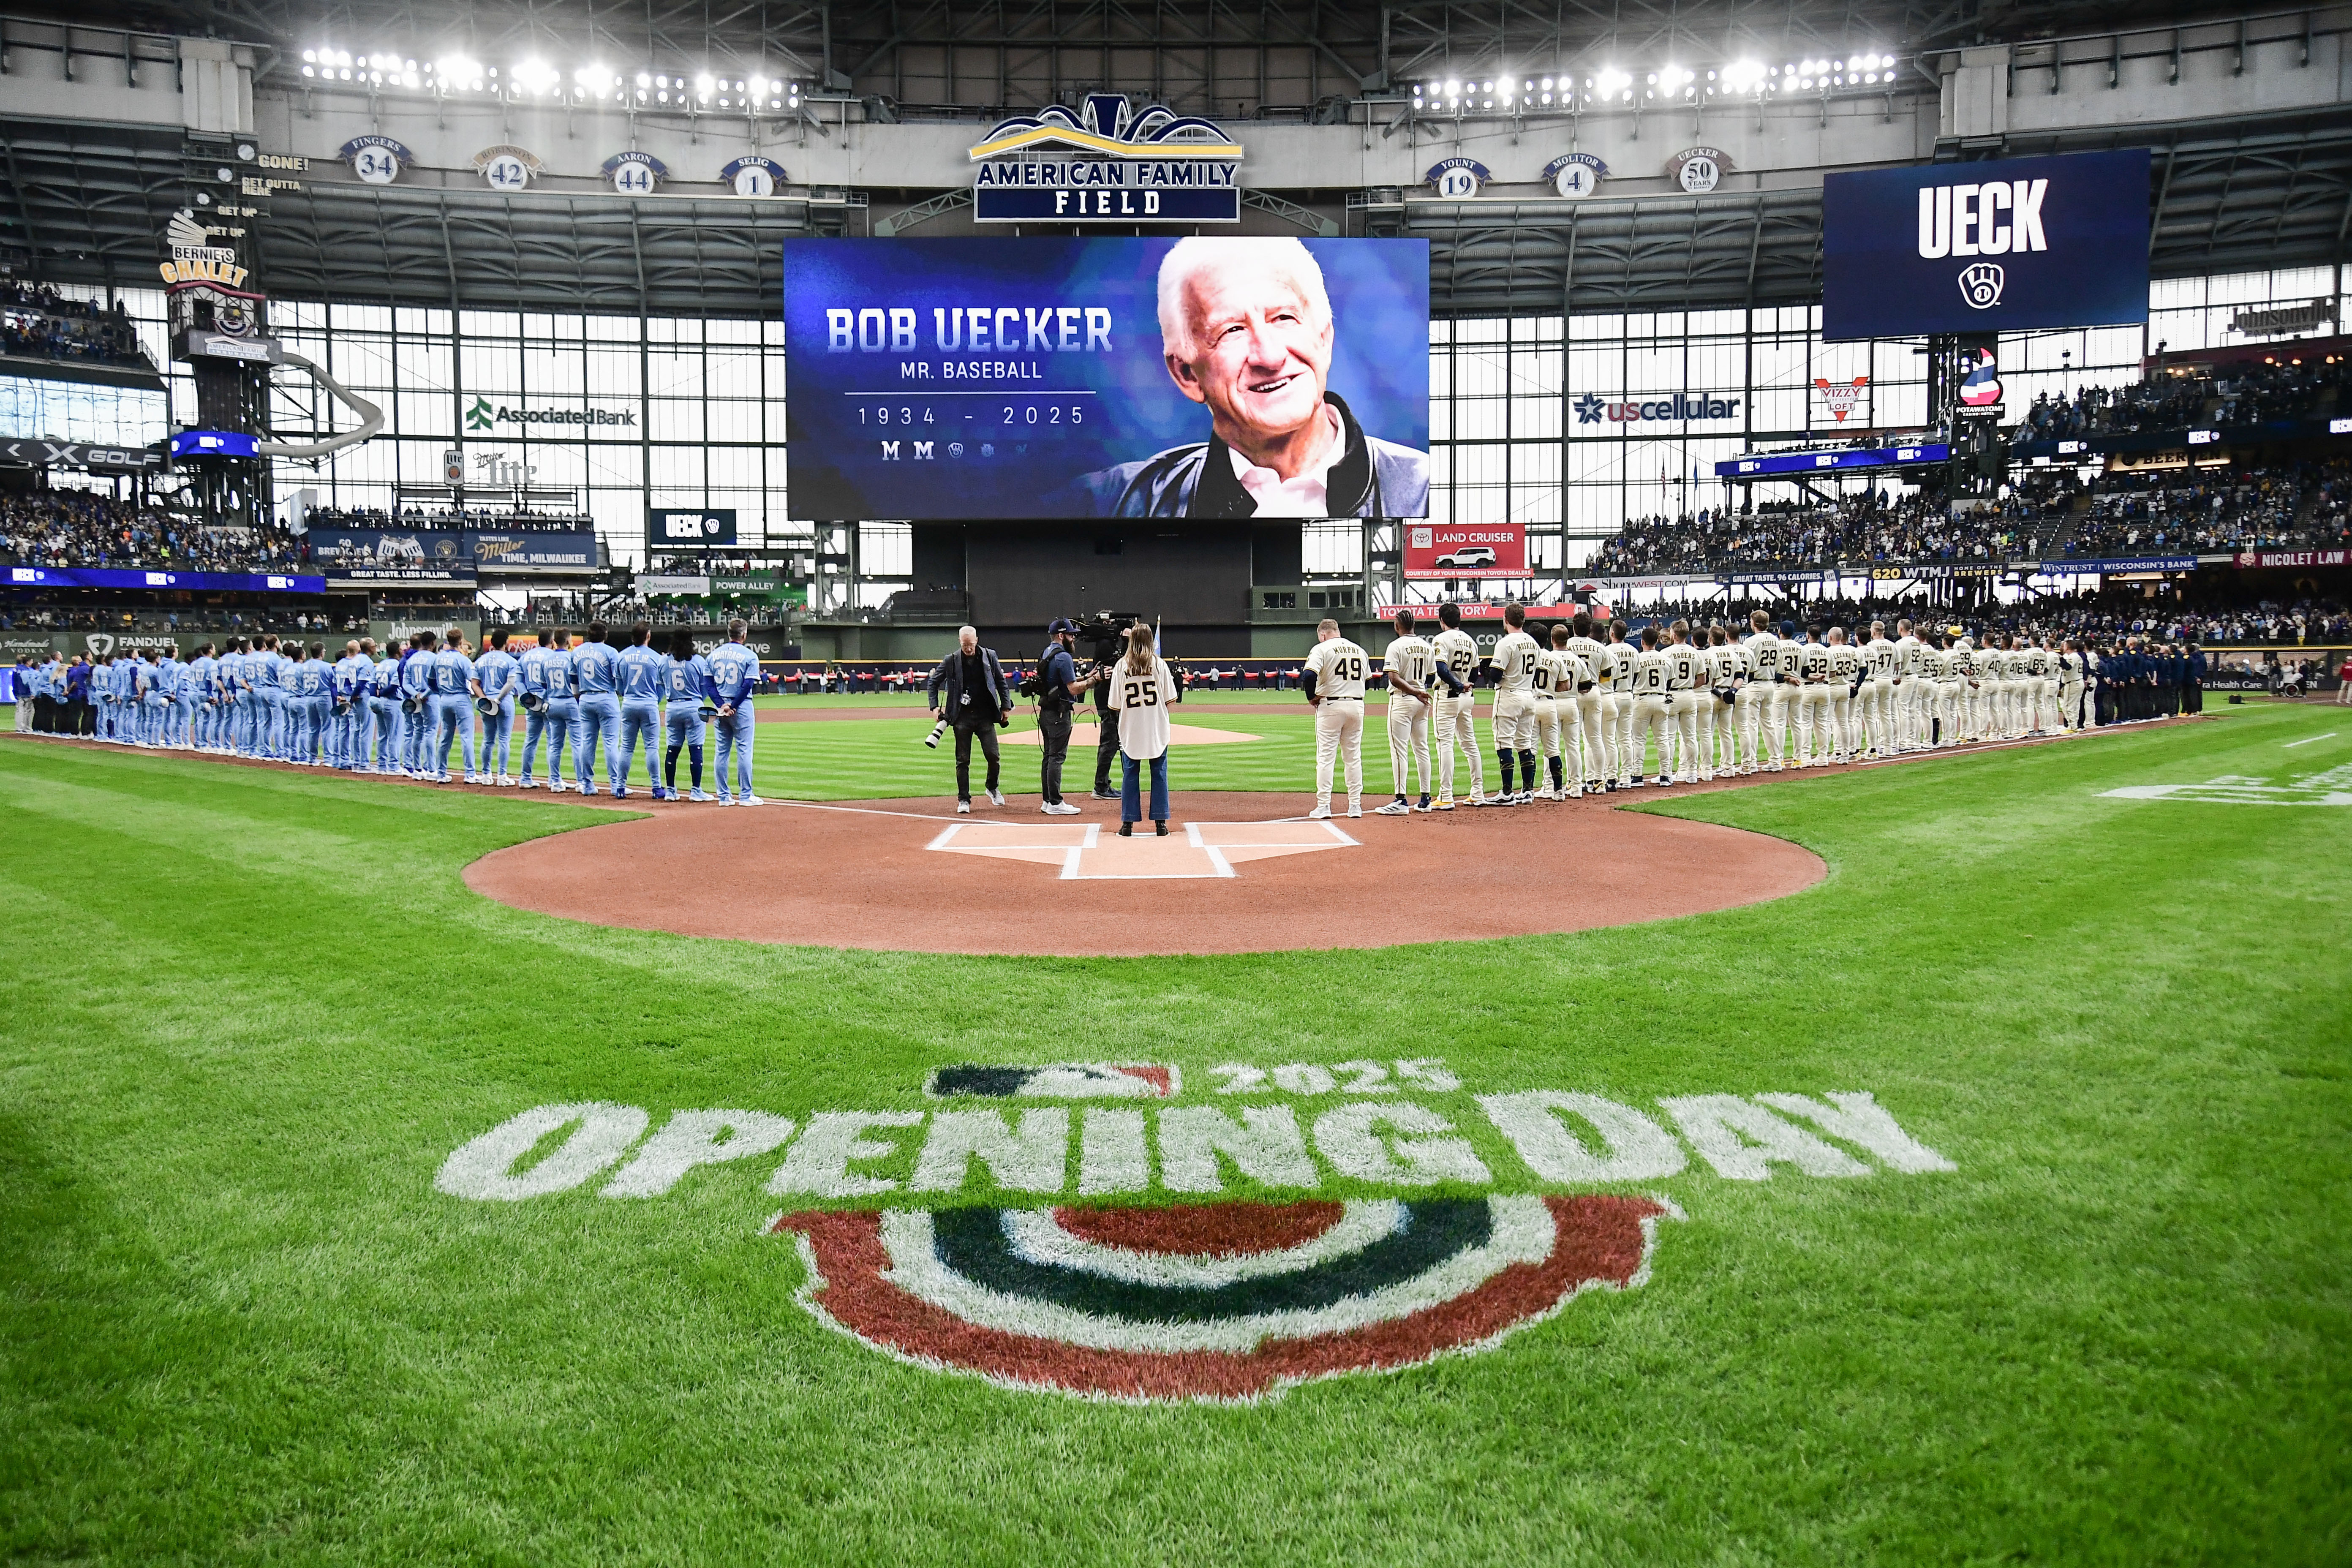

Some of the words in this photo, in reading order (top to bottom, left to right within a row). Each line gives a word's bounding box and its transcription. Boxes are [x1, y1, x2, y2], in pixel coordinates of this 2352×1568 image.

[352, 136, 401, 152] FINGERS
[482, 146, 531, 160] ROBINSON
[618, 152, 652, 164] AARON
[1678, 148, 1718, 161] UECKER
[258, 155, 309, 171] GONE!
[361, 154, 393, 177] 34
[738, 158, 769, 167] SELIG
[1440, 158, 1476, 169] YOUNT
[1552, 155, 1598, 169] MOLITOR
[491, 163, 524, 185] 42
[977, 162, 1126, 188] AMERICAN
[1136, 162, 1240, 188] FAMILY
[1687, 162, 1712, 180] 50
[242, 177, 263, 188] GET
[265, 178, 301, 190] OUTTA
[619, 169, 650, 191] 44
[750, 175, 761, 195] 1
[1445, 174, 1472, 196] 19
[1567, 172, 1582, 191] 4
[242, 186, 272, 196] HERE
[1056, 191, 1160, 214] FIELD
[218, 205, 239, 216] GET
[242, 207, 258, 218] UP
[1918, 177, 2049, 259] UECK
[206, 226, 228, 236] GET
[230, 228, 246, 237] UP
[175, 247, 234, 262] BERNIE'S
[160, 260, 248, 288] CHALET
[826, 308, 917, 353] BOB
[933, 307, 1113, 352] UECKER
[901, 362, 935, 379] MR.
[943, 361, 1043, 379] BASEBALL
[1822, 388, 1861, 397] VIZZY
[858, 407, 934, 425] 1934
[1003, 406, 1083, 424] 2025
[87, 450, 162, 466] GOLF
[882, 441, 900, 461] M
[913, 441, 934, 460] M
[2143, 452, 2186, 464] BEER
[489, 460, 537, 489] Lite
[665, 514, 703, 538] UECK
[339, 539, 352, 547] GO
[1436, 533, 1466, 543] LAND
[1468, 532, 1514, 543] CRUISER
[474, 540, 526, 561] Miller
[500, 553, 528, 564] TIME,
[529, 553, 587, 564] MILWAUKEE
[2262, 552, 2313, 566] NICOLET
[2317, 551, 2344, 564] LAW
[1872, 567, 1901, 580] 620
[1903, 566, 1950, 579] WTMJ
[2103, 561, 2164, 570] WISCONSIN'S
[1754, 574, 1776, 582] TASTE.
[1787, 572, 1822, 580] CALORIES.
[716, 581, 746, 590] POWER
[748, 582, 775, 590] ALLEY
[1381, 607, 1424, 617] TOYOTA
[1426, 605, 1488, 616] TETORY
[388, 621, 454, 640] Johnsonvill
[119, 637, 179, 647] FANDUEL
[745, 643, 771, 653] ave
[1453, 638, 1473, 649] YELICH
[1567, 644, 1600, 653] MITCHELL
[625, 654, 639, 663] WITT
[1332, 646, 1360, 655] MURPHY
[1405, 646, 1430, 655] CHOURIO
[1760, 650, 1777, 666] 29
[1911, 649, 1920, 663] 52
[544, 659, 568, 668] MASSEY
[1413, 657, 1424, 680] 11
[1451, 650, 1472, 673] 22
[1522, 653, 1535, 675] 12
[1639, 659, 1666, 669] COLLINS
[1784, 655, 1798, 672] 31
[1809, 659, 1827, 674] 32
[1836, 661, 1851, 676] 33
[1878, 653, 1893, 668] 47
[1923, 659, 1935, 672] 53
[1988, 660, 2001, 672] 40
[2033, 659, 2045, 670] 85
[414, 665, 423, 683] 11
[438, 667, 454, 686] 21
[489, 667, 495, 686] 1
[583, 659, 595, 679] 9
[630, 664, 643, 686] 7
[713, 662, 738, 685] 33
[1334, 657, 1361, 681] 49
[1620, 660, 1629, 679] 2
[1679, 662, 1689, 680] 9
[548, 669, 565, 689] 19
[671, 669, 685, 691] 6
[1648, 668, 1659, 687] 6
[2212, 680, 2240, 689] Health
[2242, 681, 2262, 689] Care
[1124, 681, 1157, 708] 25
[1211, 1056, 1462, 1096] 2025
[434, 1098, 1492, 1202] OPENING
[1480, 1089, 1959, 1183] DAY
